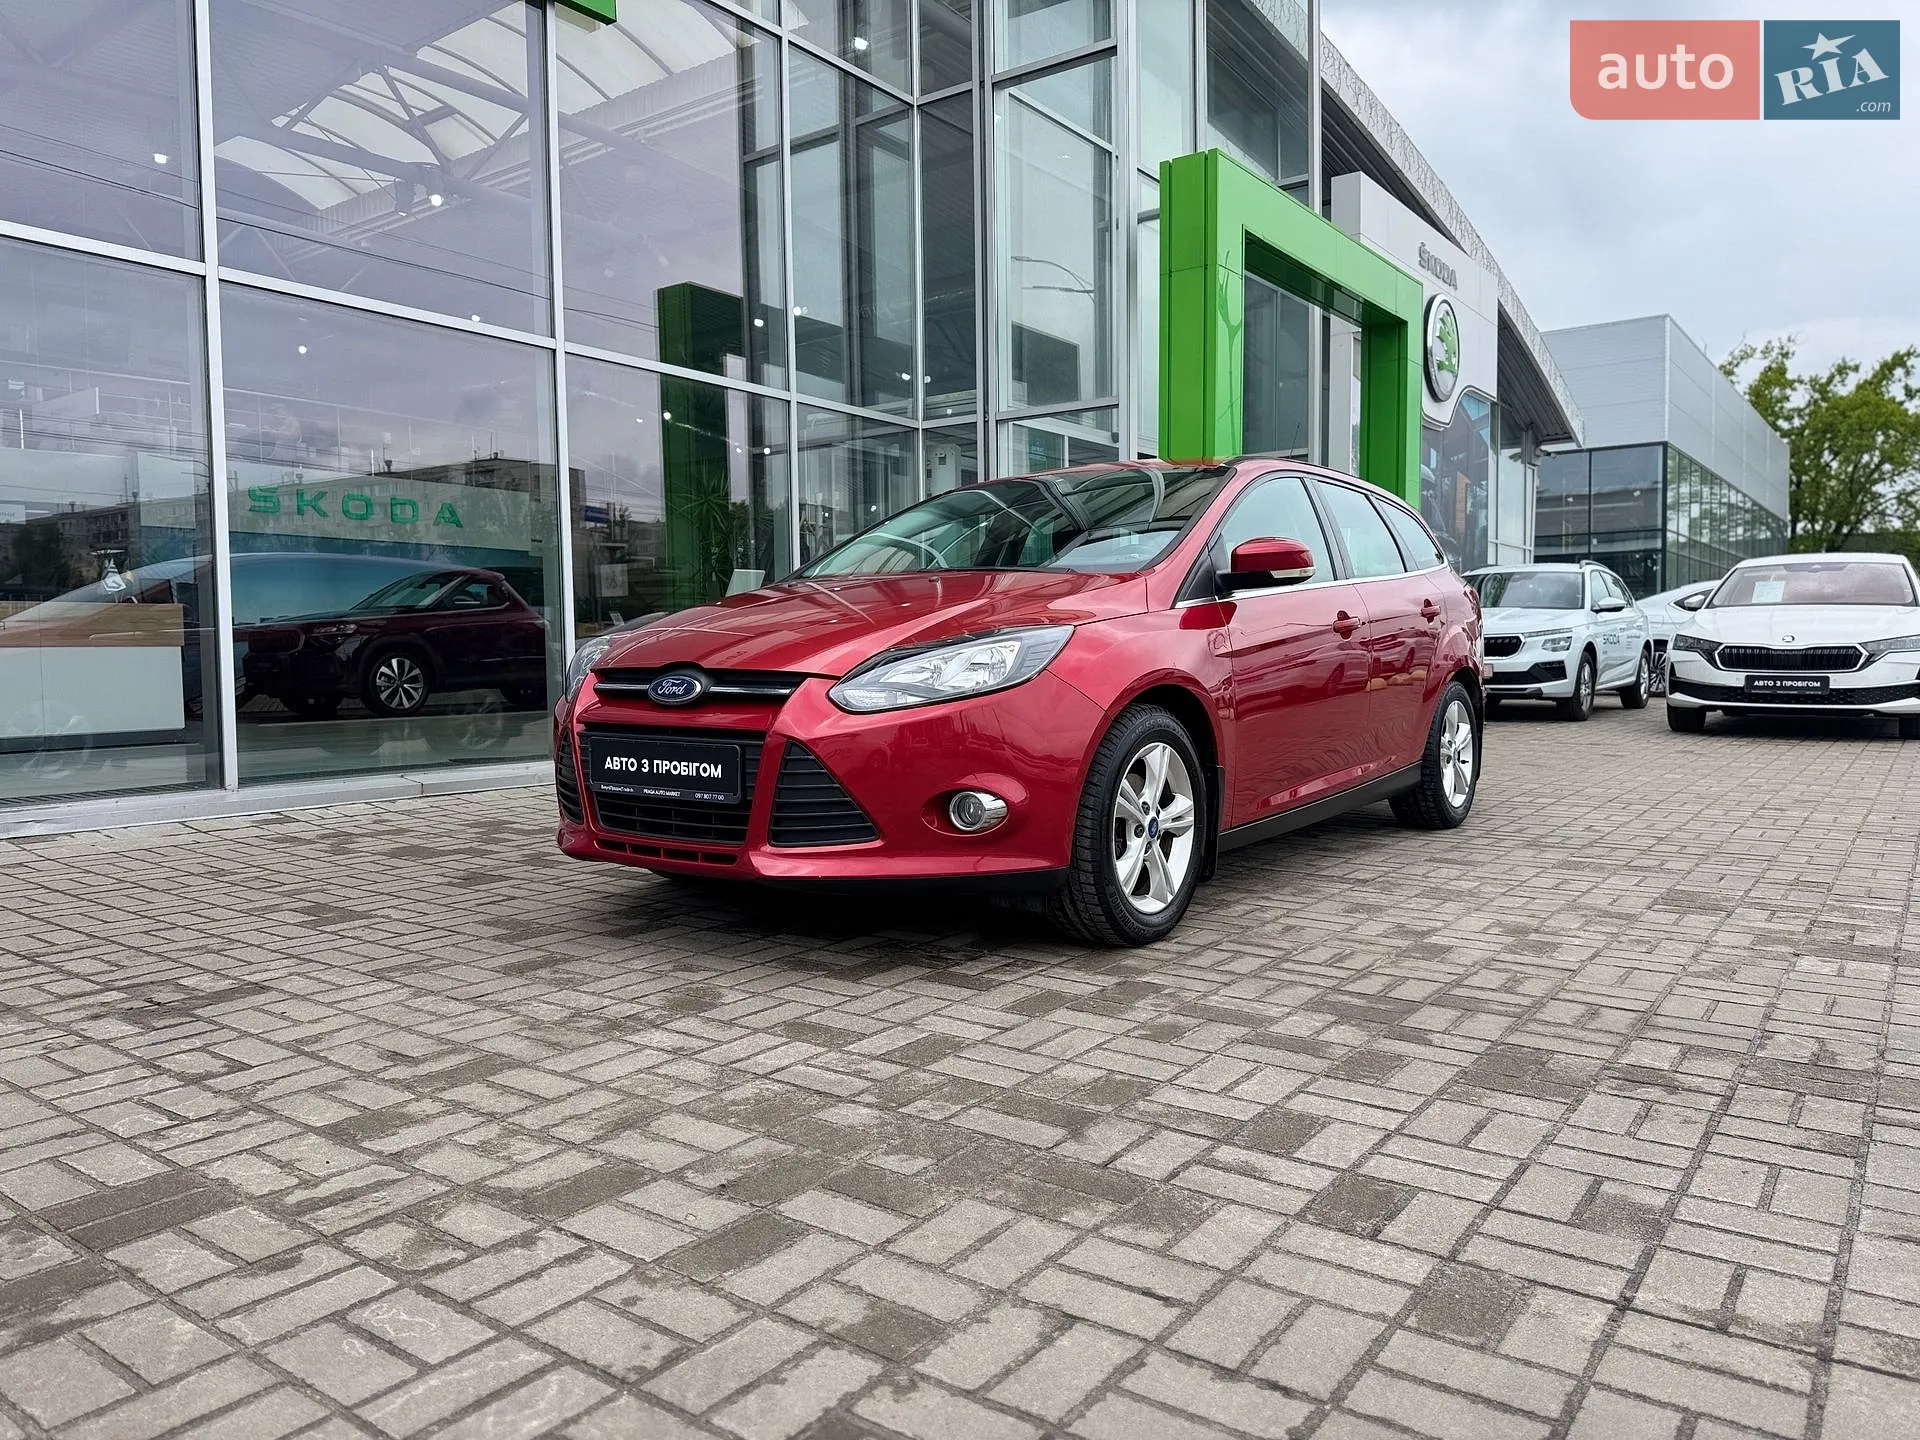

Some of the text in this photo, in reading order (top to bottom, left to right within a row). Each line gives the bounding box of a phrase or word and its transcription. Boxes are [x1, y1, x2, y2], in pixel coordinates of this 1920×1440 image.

[657, 679, 688, 695] Ford
[1753, 679, 1774, 687] АВТО
[1782, 680, 1821, 688] ПРОБІГОМ
[604, 756, 638, 772] АВТО
[653, 759, 722, 778] ПРОБІГОМ
